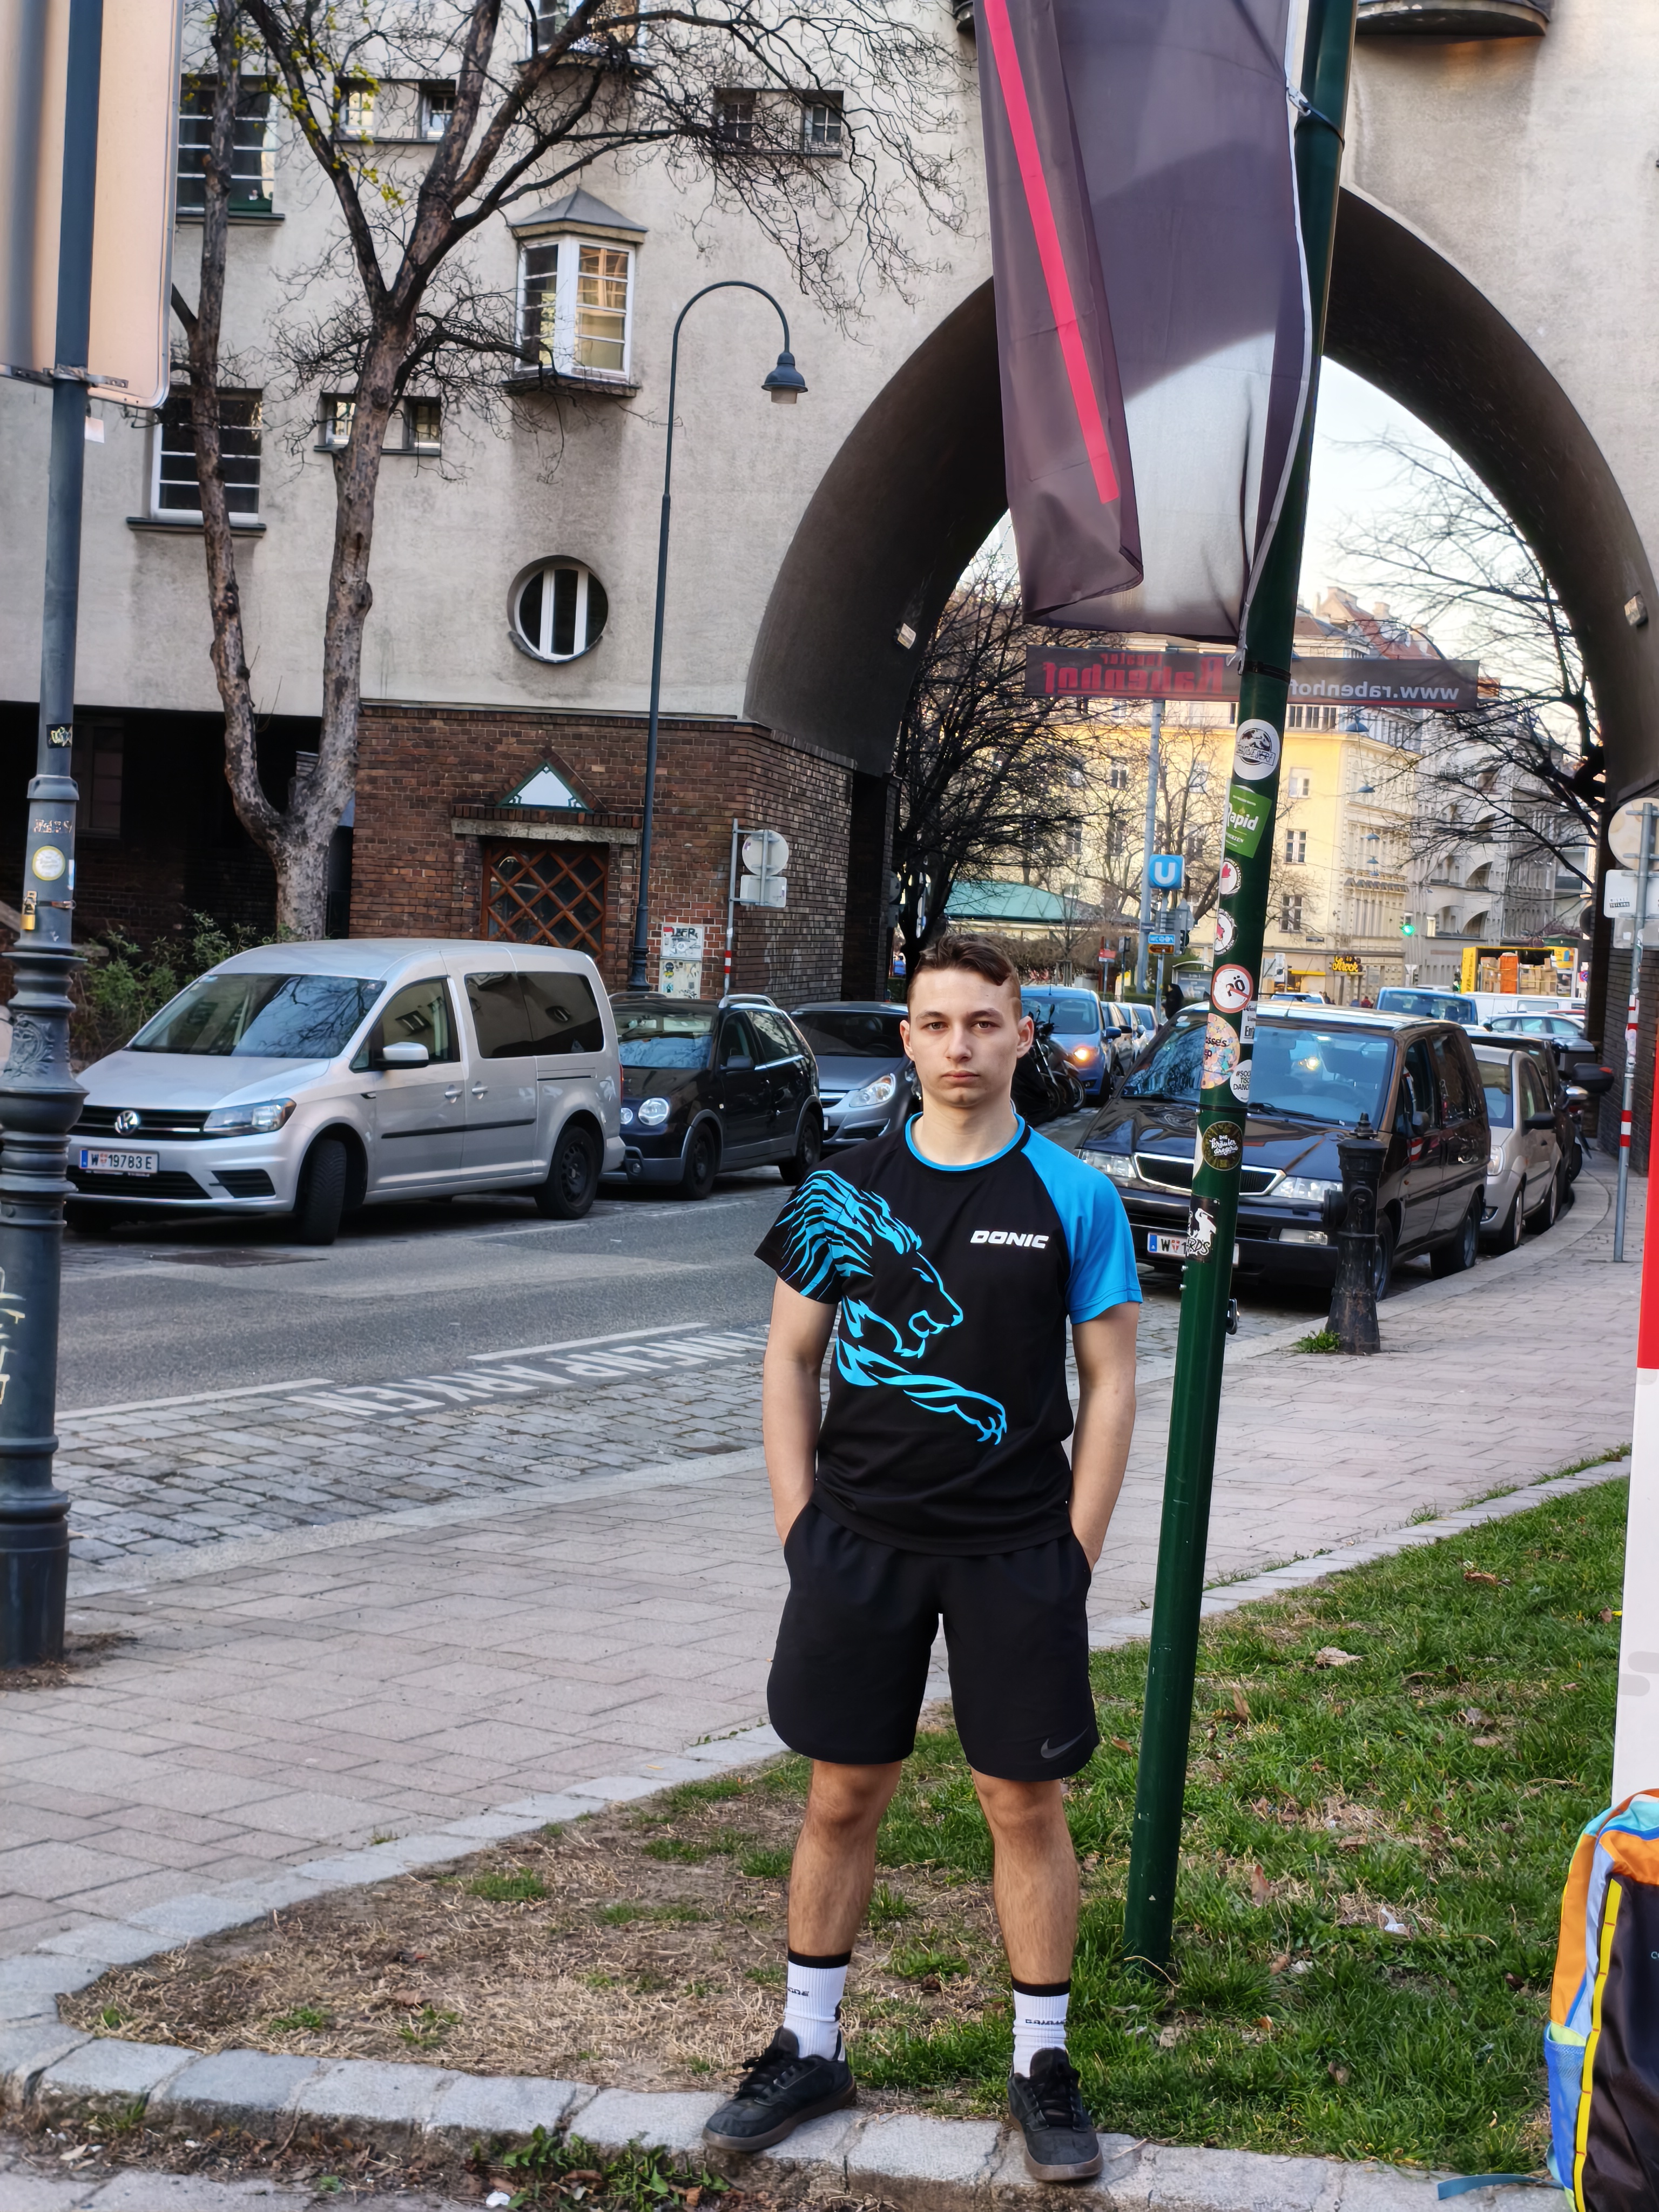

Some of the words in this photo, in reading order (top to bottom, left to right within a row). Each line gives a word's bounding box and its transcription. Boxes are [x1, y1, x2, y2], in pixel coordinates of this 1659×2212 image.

[1155, 861, 1176, 884] U
[91, 1153, 99, 1166] W
[970, 1230, 1049, 1249] DONIC
[1161, 1238, 1170, 1252] W
